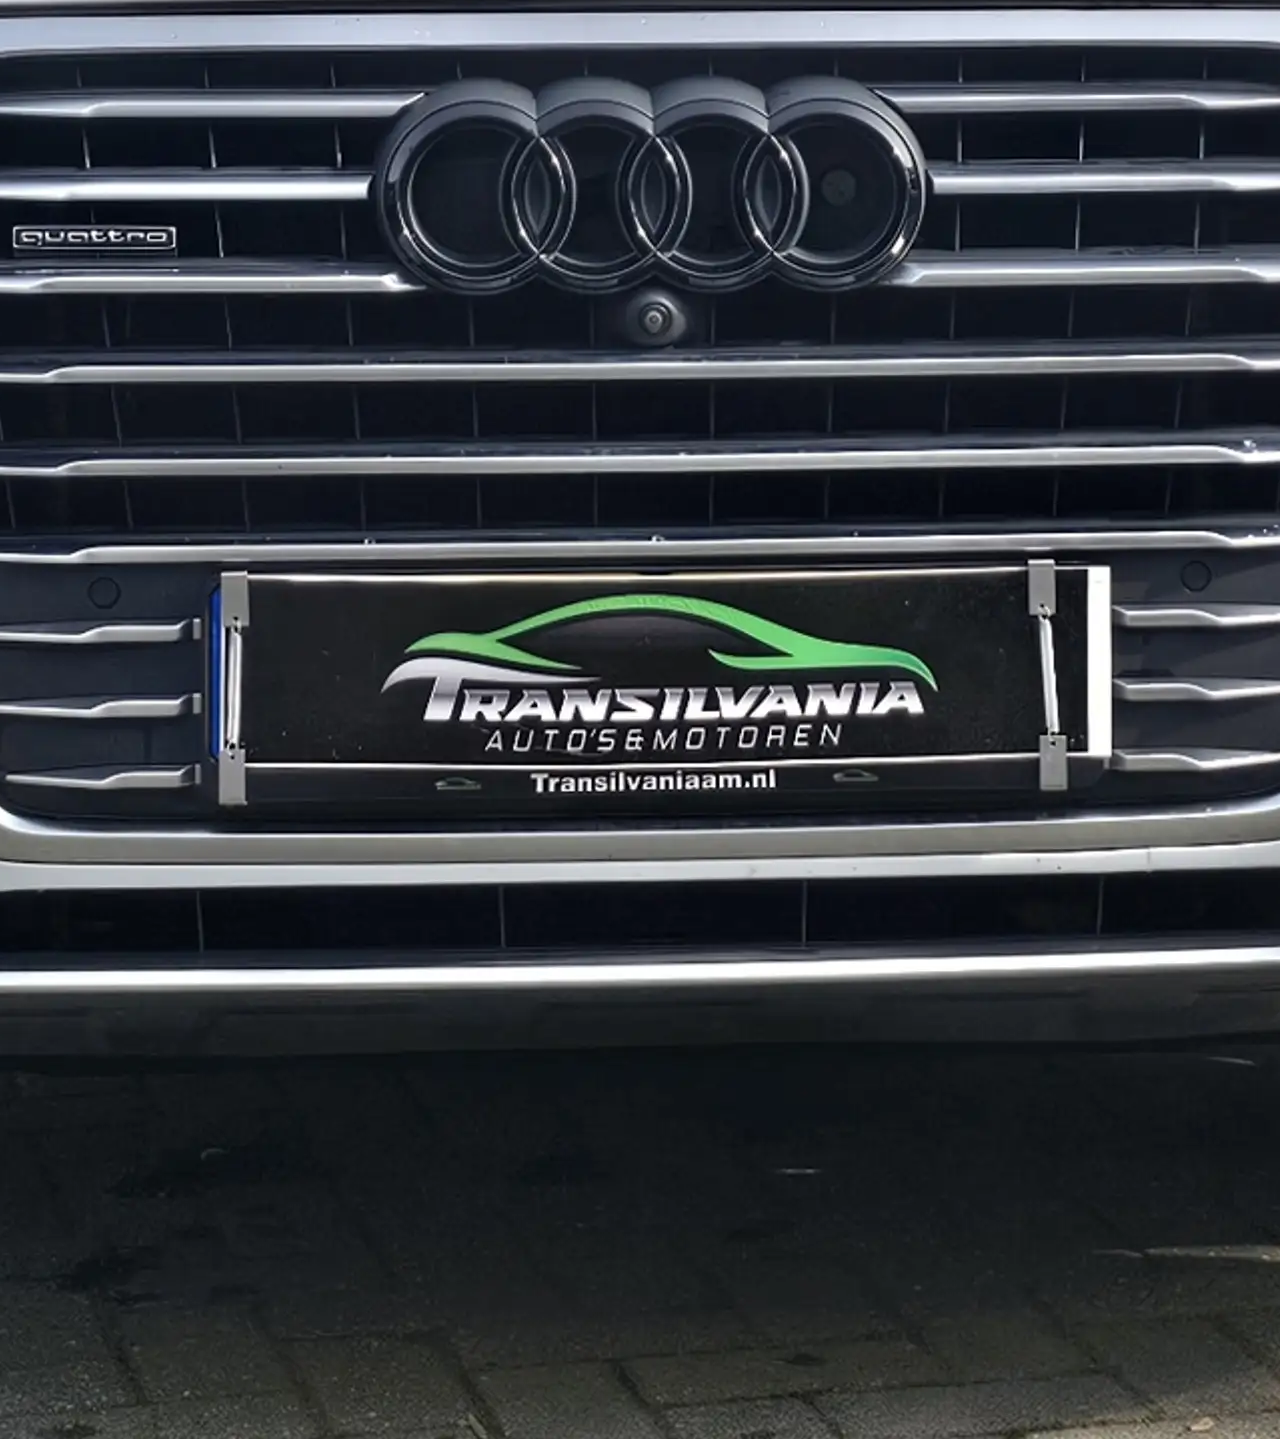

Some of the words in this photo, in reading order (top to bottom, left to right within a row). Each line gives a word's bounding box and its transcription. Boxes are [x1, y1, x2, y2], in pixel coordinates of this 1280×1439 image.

[20, 229, 169, 246] quattro
[382, 657, 924, 721] TRANSILVANIA
[531, 768, 777, 793] Transilvaniaam.nl
